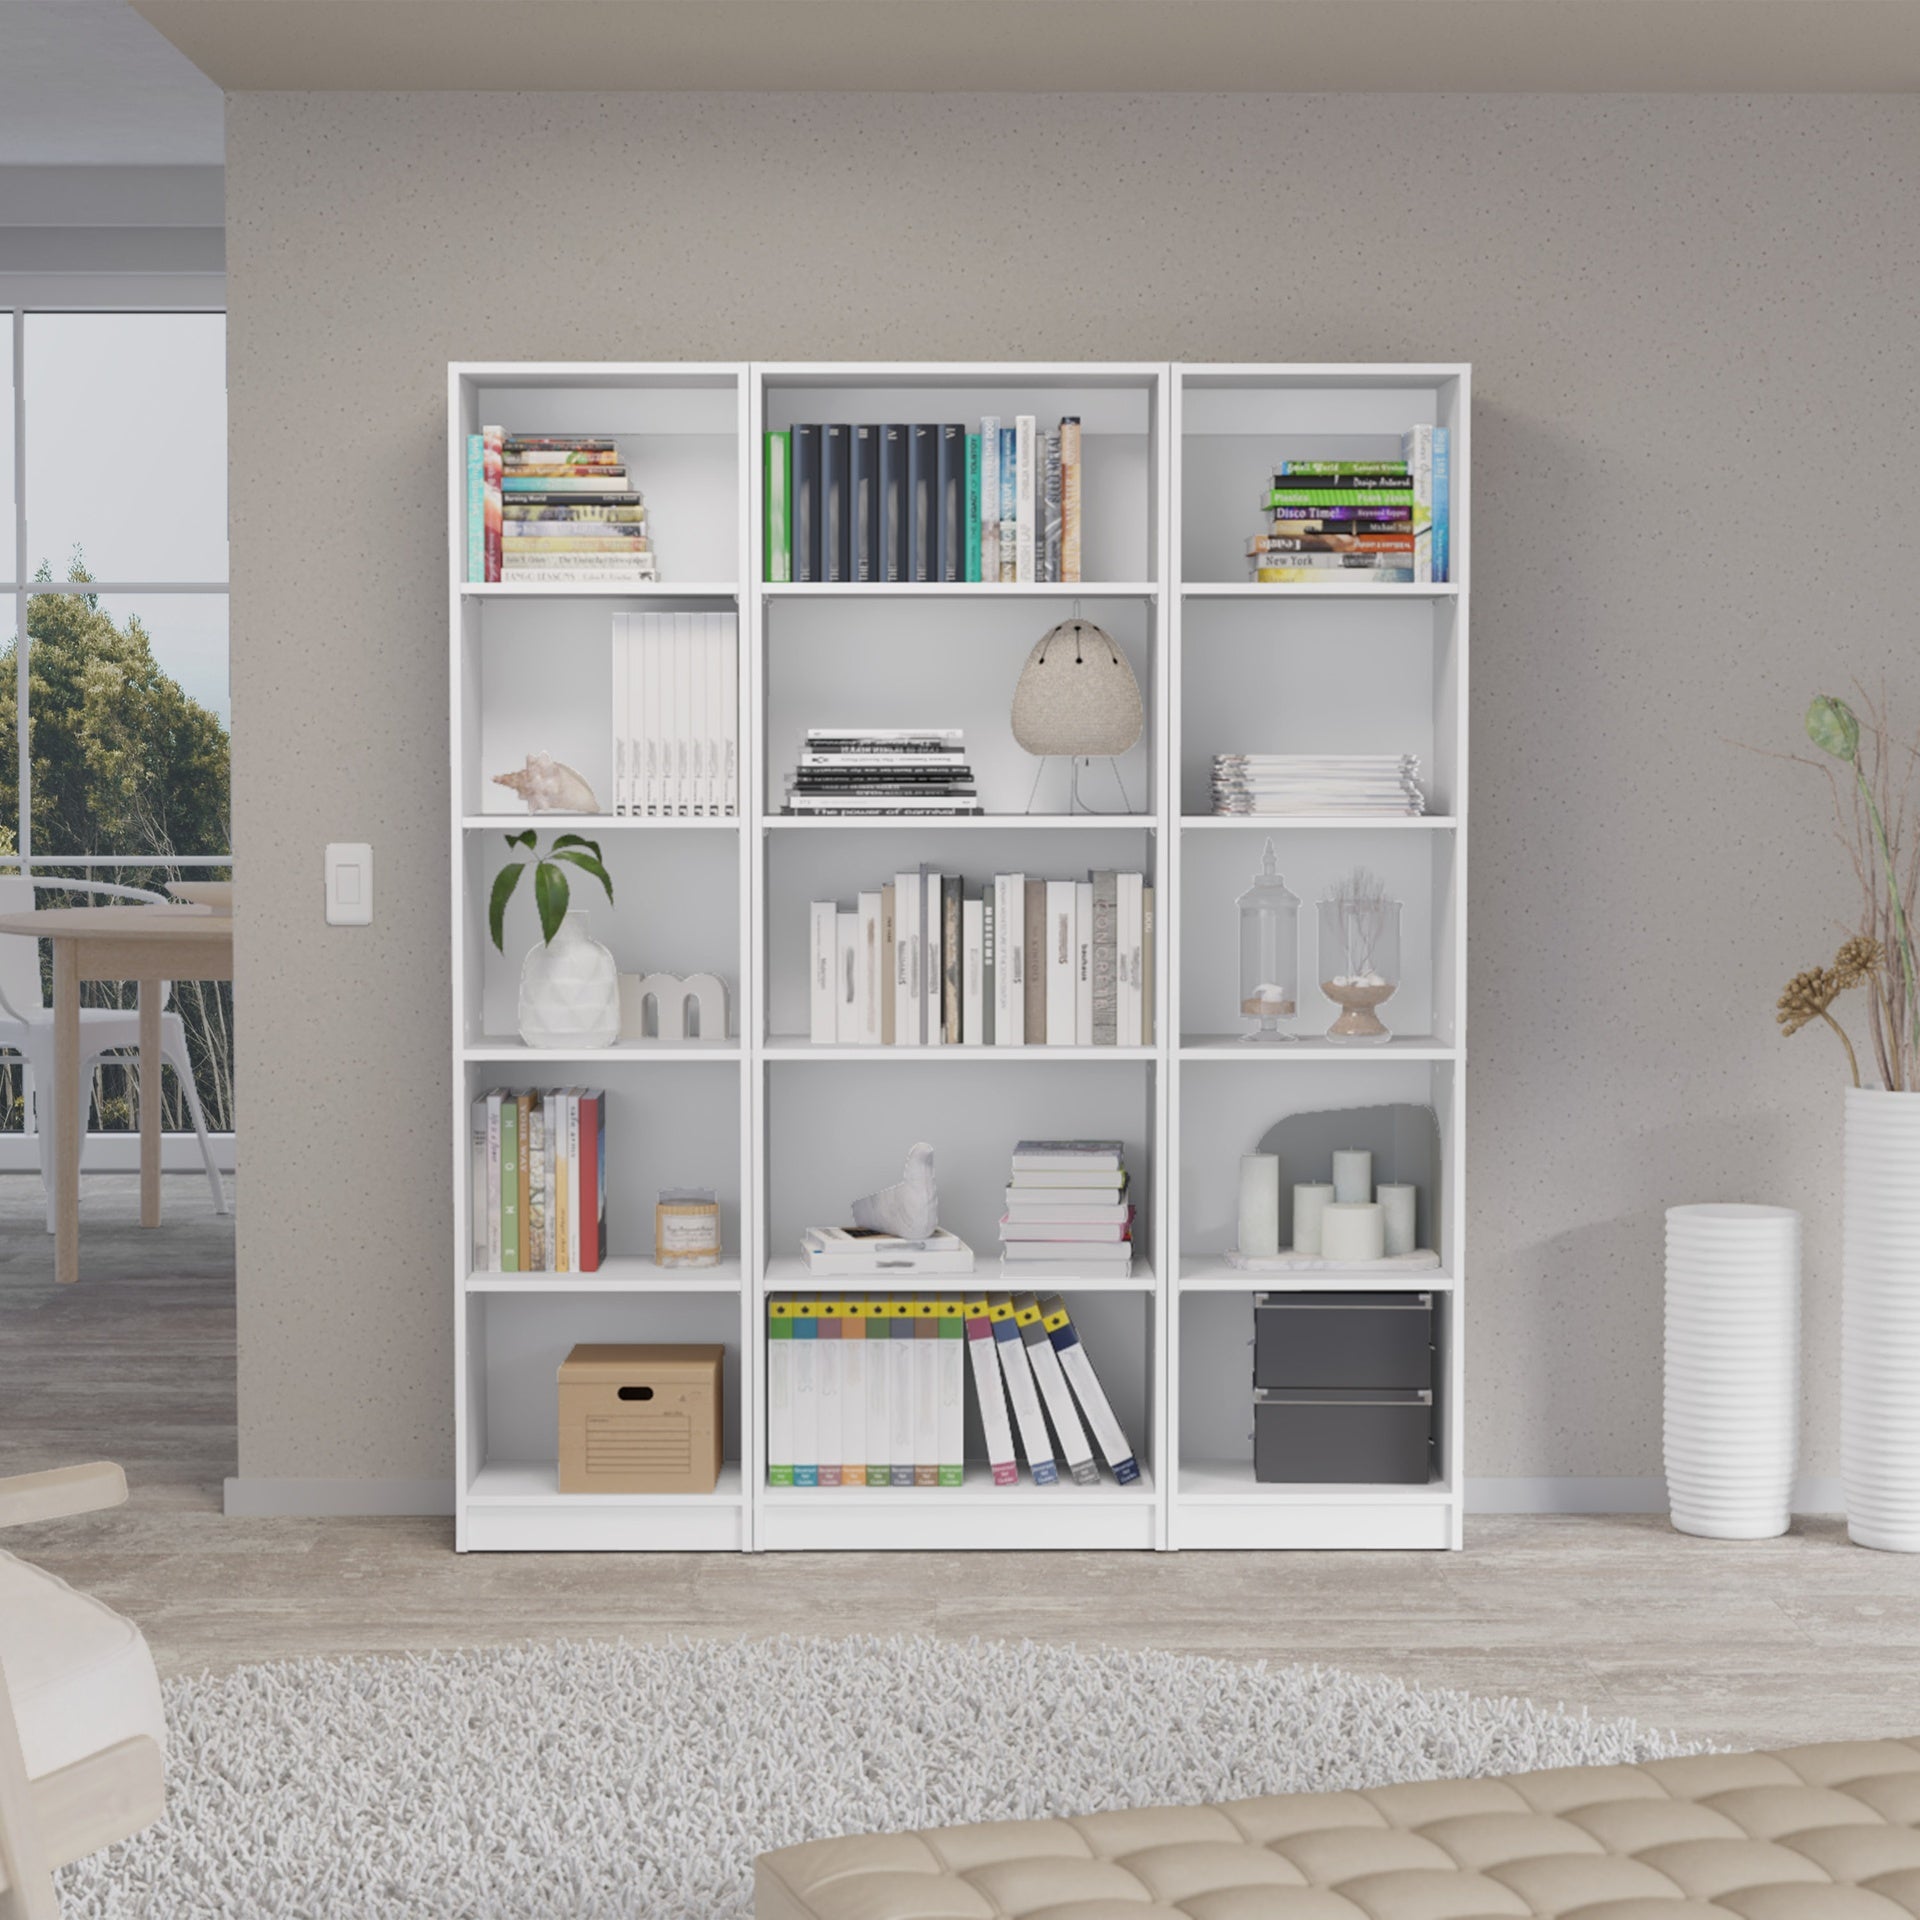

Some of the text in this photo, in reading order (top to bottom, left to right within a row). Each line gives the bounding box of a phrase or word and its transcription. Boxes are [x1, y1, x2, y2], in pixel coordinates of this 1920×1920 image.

[1276, 507, 1340, 519] Disco Time!
[1265, 556, 1313, 567] New York
[813, 808, 956, 817] The power of carnival
[985, 906, 993, 966] MUSEUMS
[1081, 944, 1089, 981] bauhaus
[519, 1104, 527, 1174] YOUR WAY
[504, 1120, 514, 1256] HOME
